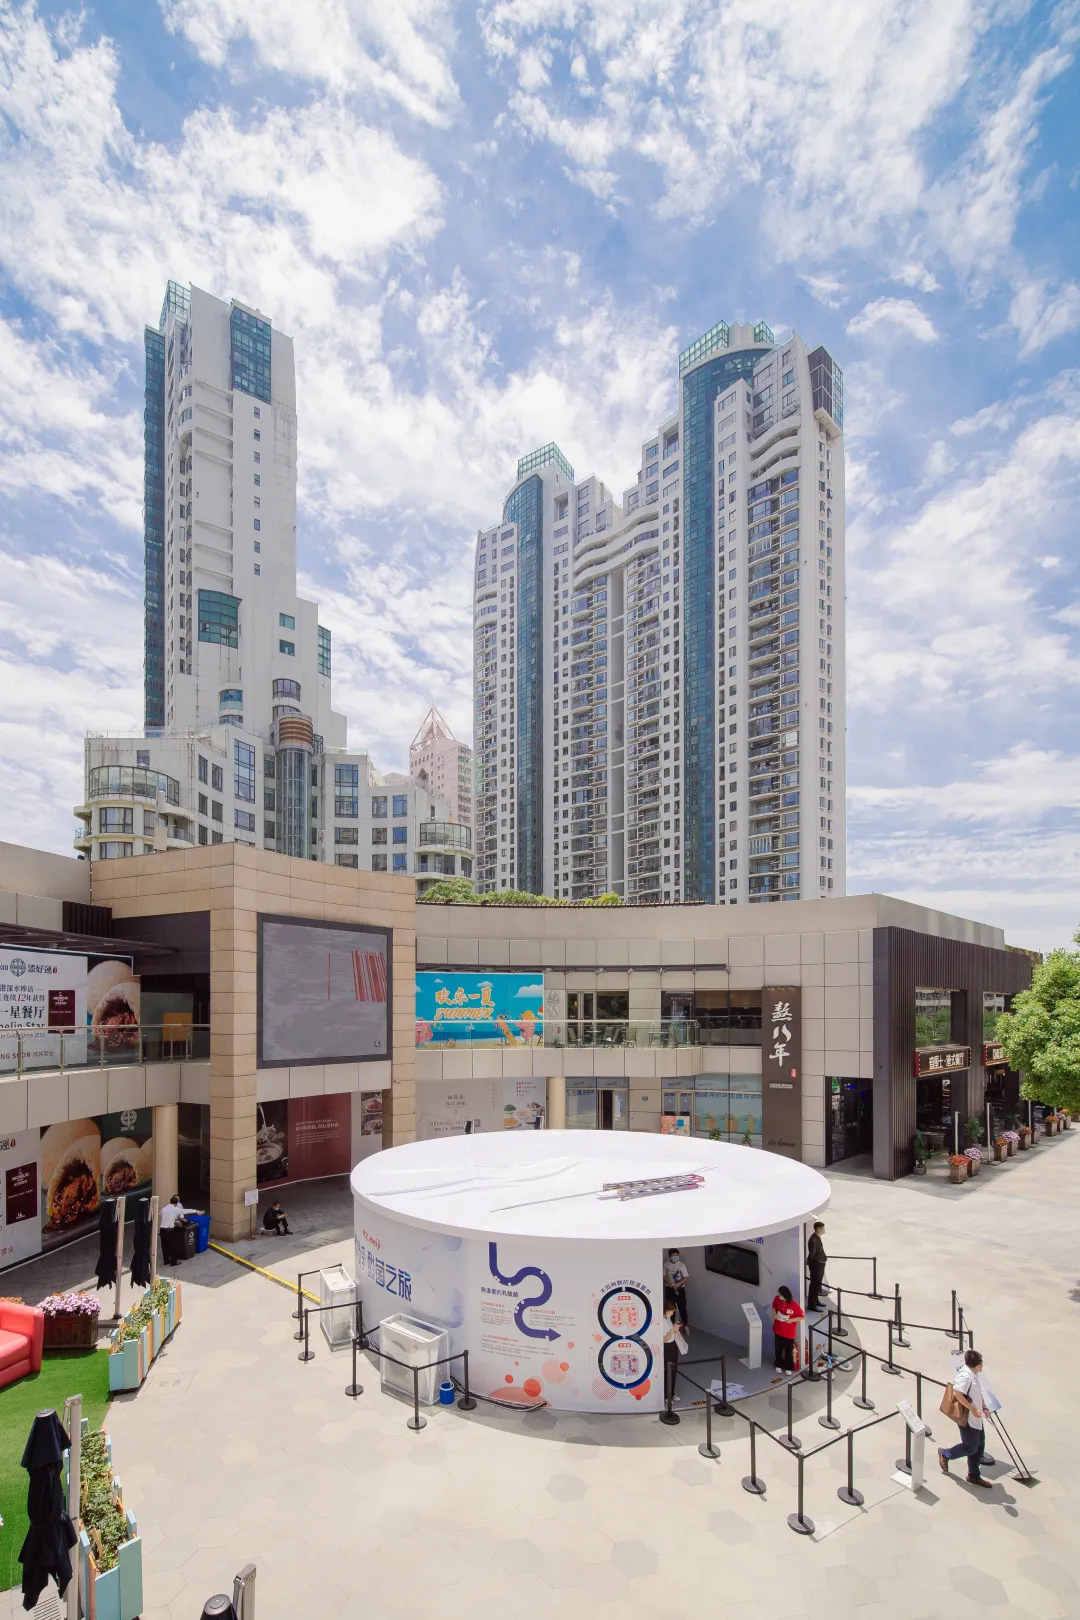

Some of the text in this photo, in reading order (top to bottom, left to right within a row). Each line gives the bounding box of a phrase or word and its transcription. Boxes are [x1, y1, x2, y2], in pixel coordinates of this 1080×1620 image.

[435, 986, 496, 1007] 欢乐一夏
[433, 1006, 495, 1021] SUMMER
